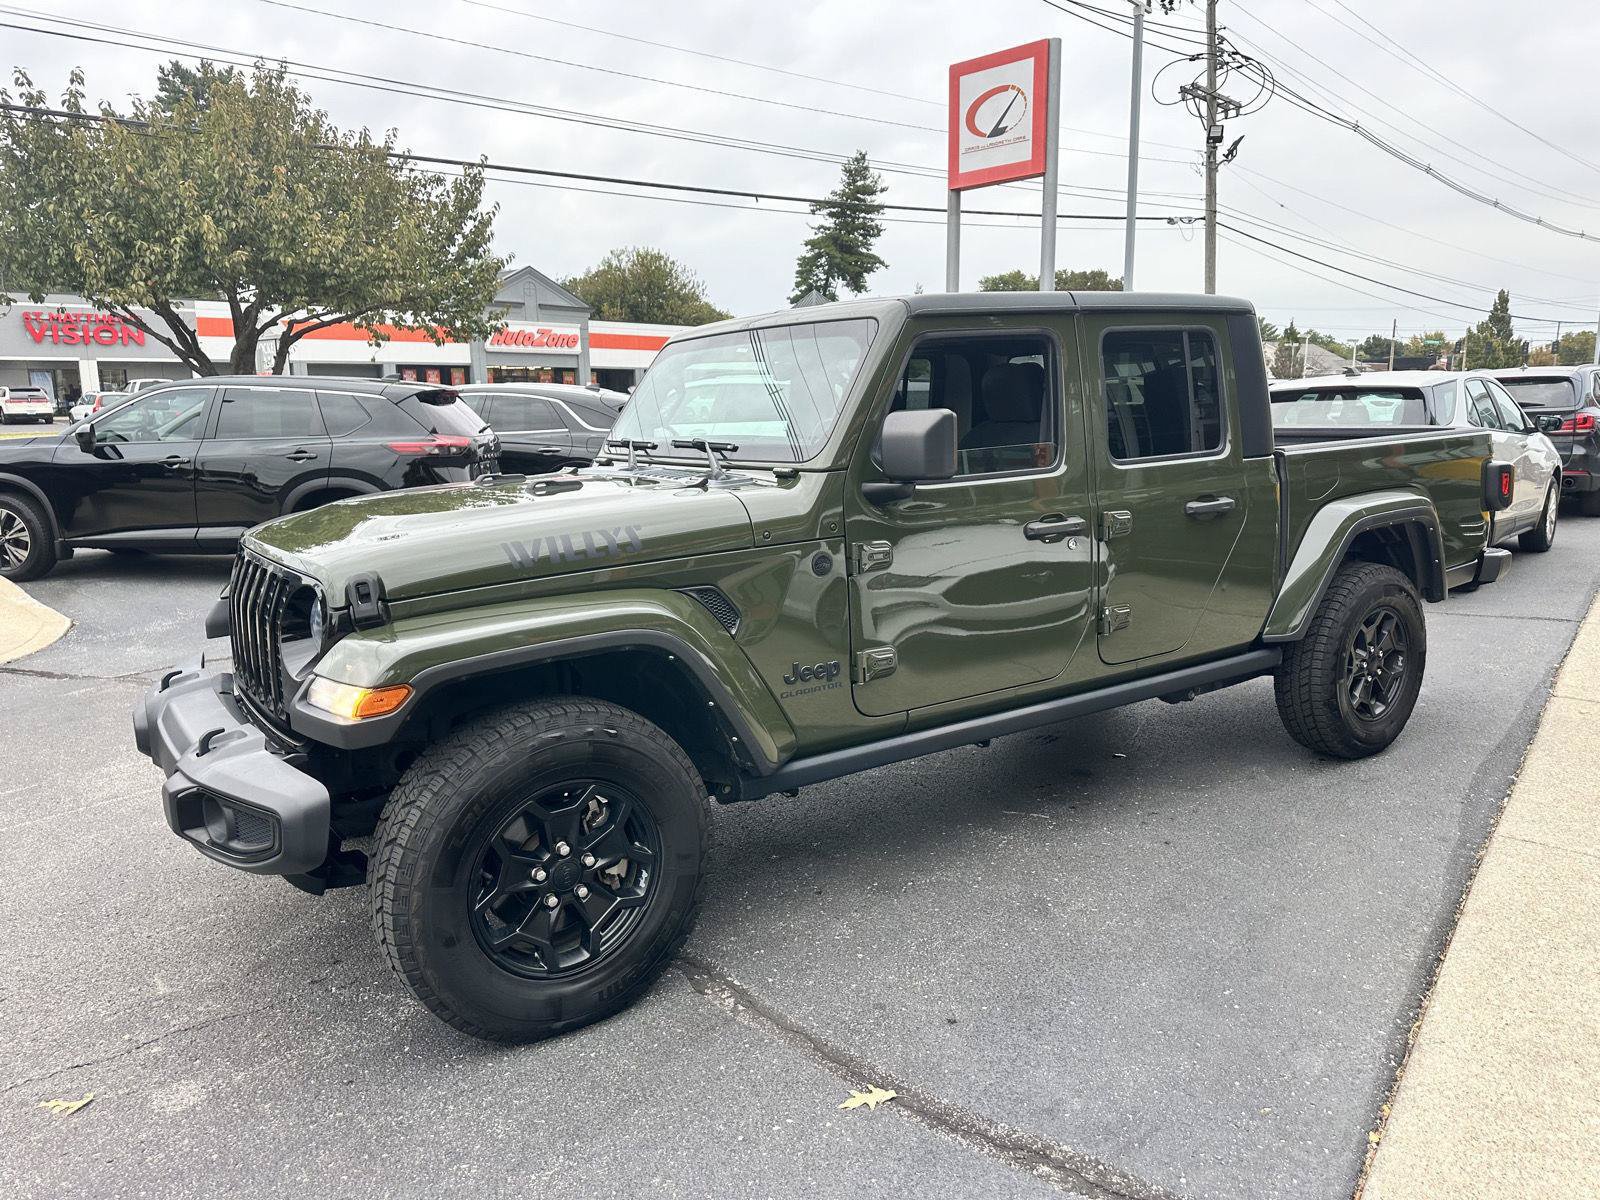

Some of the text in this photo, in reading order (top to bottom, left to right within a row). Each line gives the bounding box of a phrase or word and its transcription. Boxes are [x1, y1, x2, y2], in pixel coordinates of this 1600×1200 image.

[24, 321, 145, 346] VISION
[490, 328, 579, 348] AutoZone
[501, 525, 642, 569] WILLYS
[783, 661, 840, 685] Jeep
[780, 682, 843, 699] GLADIATOR
